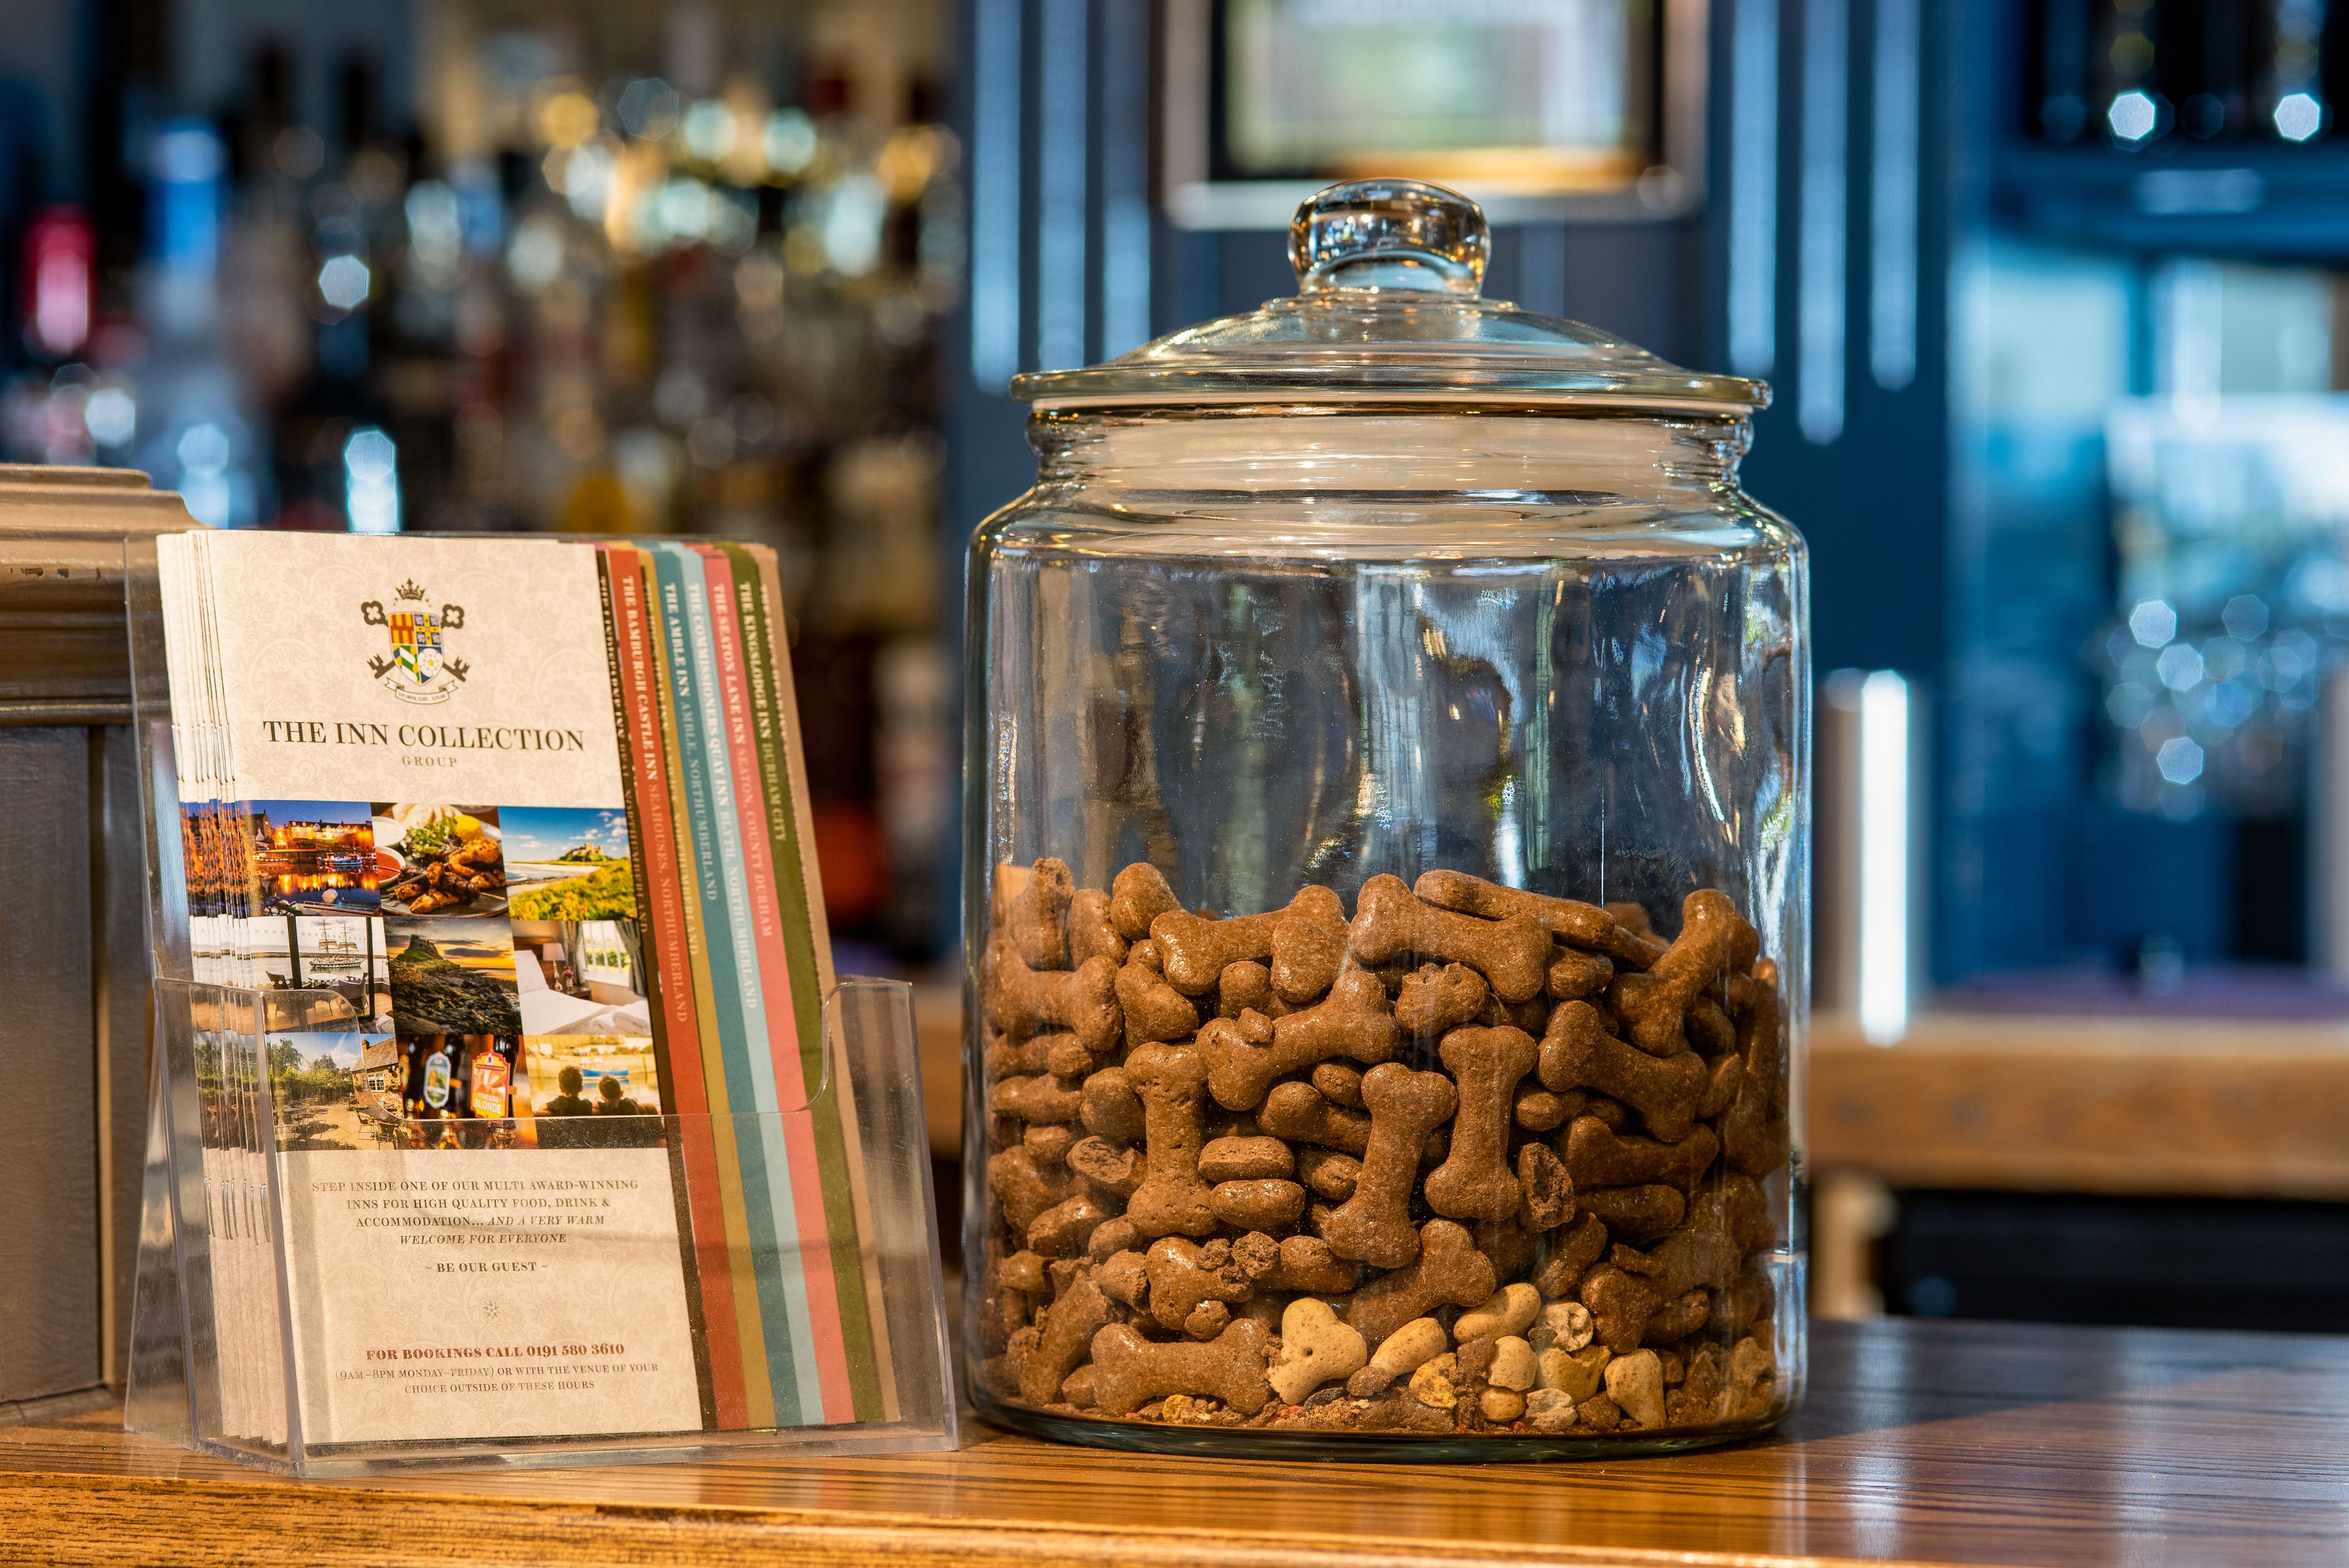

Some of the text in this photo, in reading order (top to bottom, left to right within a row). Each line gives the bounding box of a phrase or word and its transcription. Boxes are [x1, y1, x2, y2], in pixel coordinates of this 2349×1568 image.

[687, 583, 703, 613] THE
[738, 581, 754, 613] THE
[692, 614, 720, 735] COMMISSIONERS
[743, 614, 767, 709] KINGSLODGE
[262, 720, 584, 751] THE INN COLLECTION
[757, 712, 772, 739] INN
[664, 583, 717, 900] THE AMBLE INN AMBLE, NORTHUMBERLAND
[402, 755, 457, 768] GROUP
[707, 737, 725, 775] QUAY
[712, 583, 773, 937] THE SEATON LANE INN SEATON, COUNTY DURHAM
[761, 742, 781, 805] DURHAM
[621, 576, 688, 1022] THE BAMBURGH CASTLE INN SEAHOUSES, NORTHUMBERLAND
[714, 778, 729, 806] INN
[770, 807, 787, 843] CITY
[727, 865, 757, 1009] NORTHUMBERLAND
[474, 1099, 502, 1114] BLONDE
[477, 1092, 500, 1103] TYNESIDE
[312, 1180, 638, 1192] STEP INSIDE ONE OF OUR MULTI AWARD-WINNING
[347, 1198, 610, 1210] INNS FOR HIGH QUALITY FOOD, DRINK &
[356, 1215, 605, 1227] ACCOMMODATION... AND A VERY WARM
[400, 1233, 566, 1245] WELCOME FOR EVERYONE
[437, 1262, 537, 1272] BE OUR GUEST
[366, 1343, 625, 1360] FOR BOOKINGS CALL 0191 580 3610
[497, 1368, 513, 1376] OR
[516, 1367, 544, 1375] WITH
[547, 1366, 570, 1374] THE
[573, 1365, 609, 1374] VENUE
[612, 1364, 626, 1373] OF
[630, 1363, 658, 1373] YOUR
[405, 1381, 594, 1394] CHOICE OUTSIDE OF THESE HOURS
